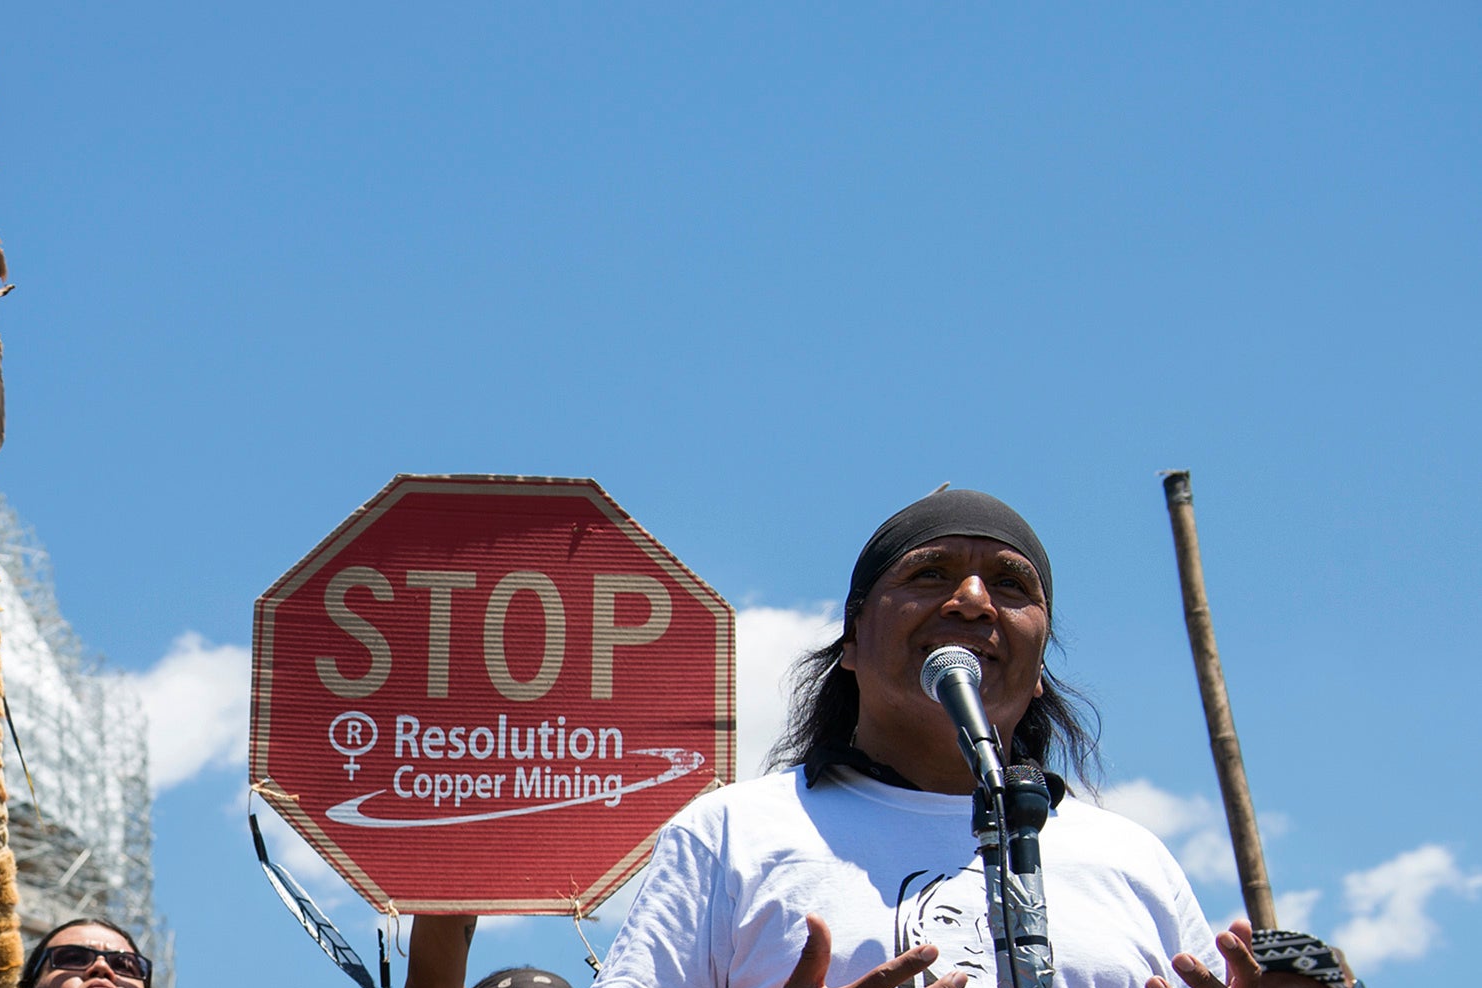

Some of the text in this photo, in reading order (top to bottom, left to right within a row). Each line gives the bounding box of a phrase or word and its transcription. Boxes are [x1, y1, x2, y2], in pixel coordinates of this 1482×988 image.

[314, 565, 673, 701] STOP
[394, 713, 624, 760] Resolution
[392, 765, 624, 808] Copper Mining
